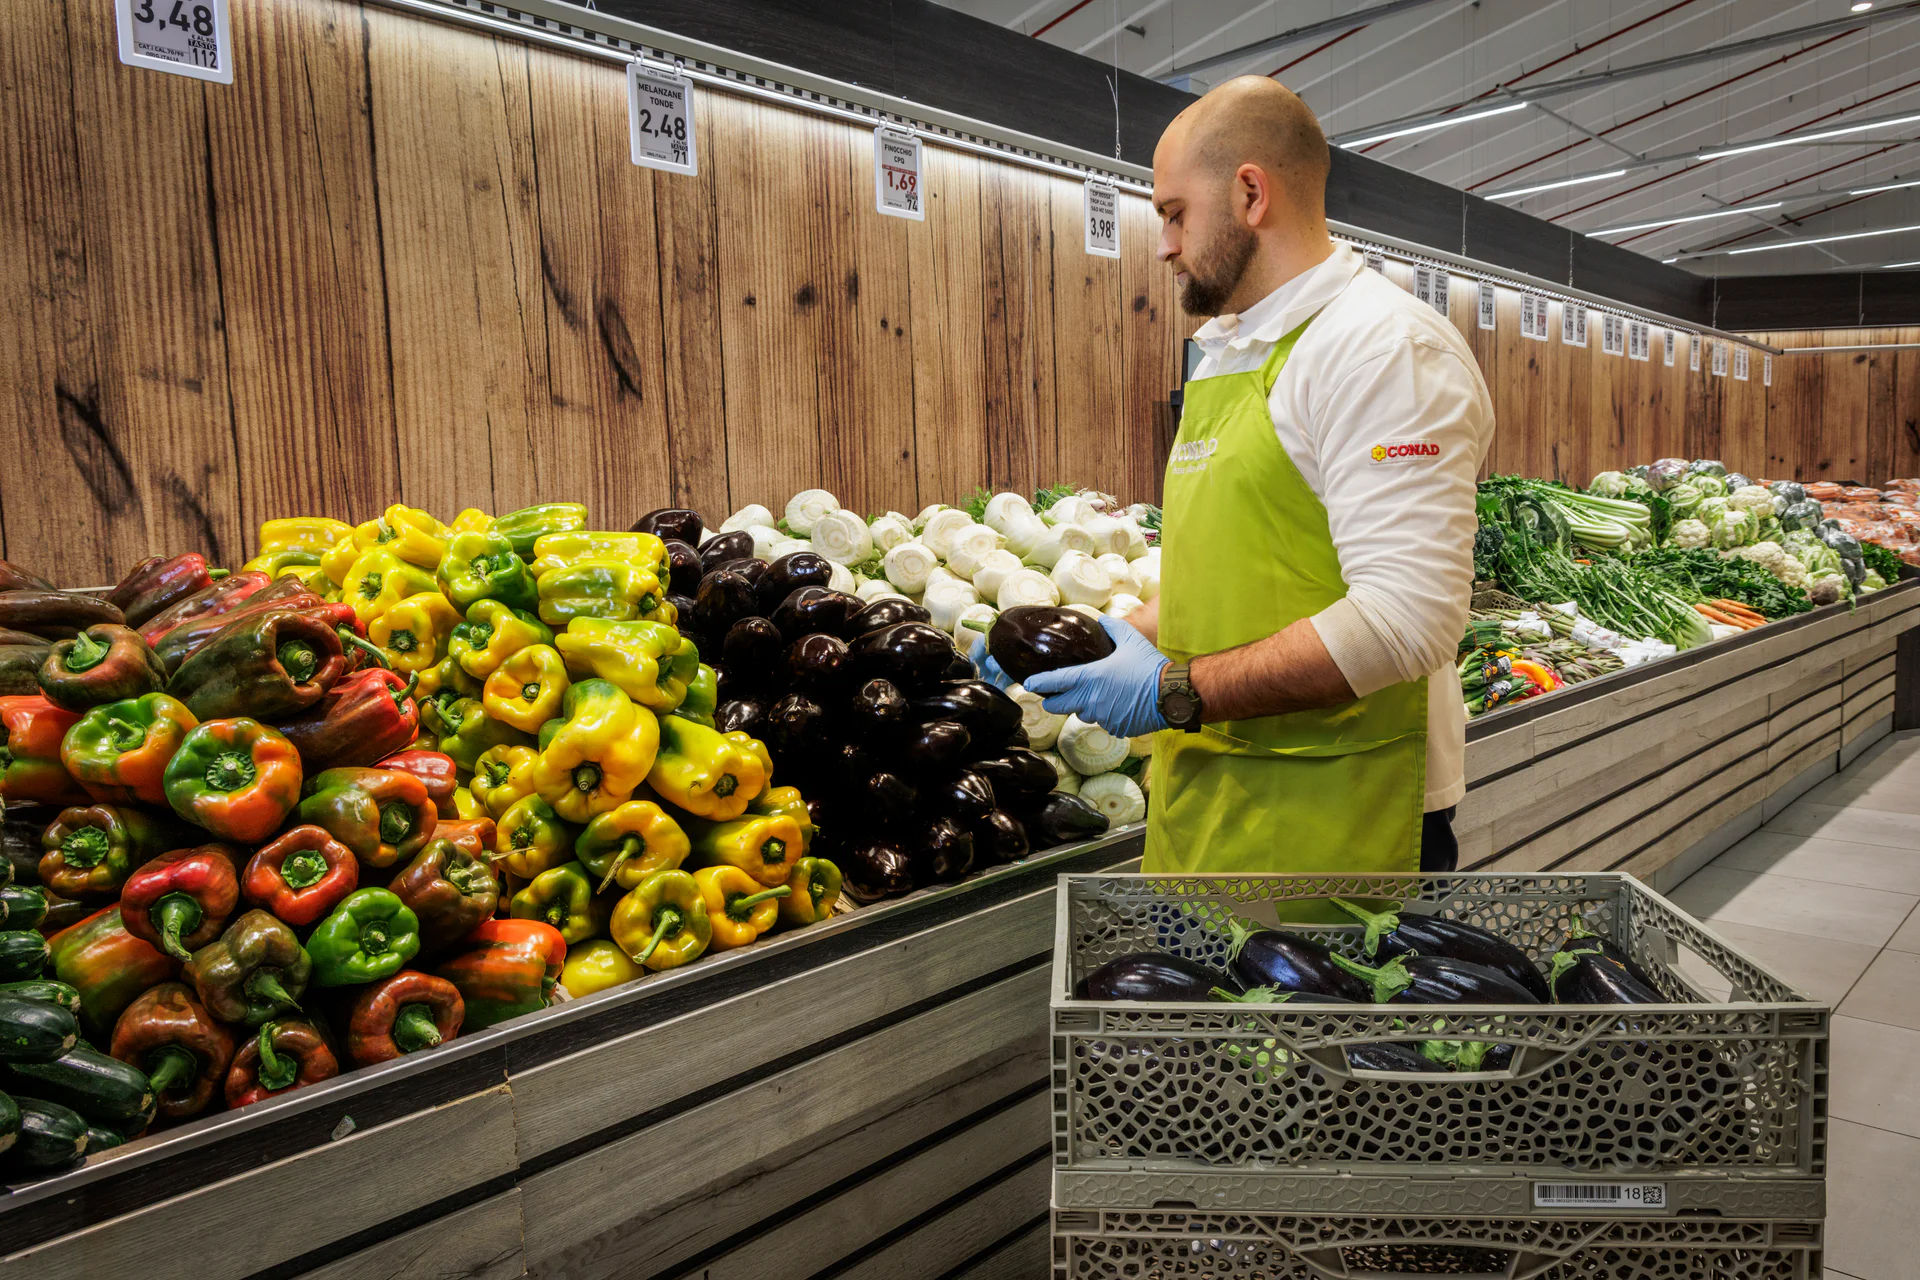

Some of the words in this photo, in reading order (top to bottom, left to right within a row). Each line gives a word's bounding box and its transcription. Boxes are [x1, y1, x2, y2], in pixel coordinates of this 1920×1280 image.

[134, 0, 213, 36] 3,48
[193, 47, 217, 68] 112
[638, 83, 682, 100] MELANZANE
[650, 96, 674, 109] TONDE
[640, 109, 686, 141] 2,48
[673, 150, 687, 165] 71
[884, 143, 913, 157] FINOCCHIO
[893, 155, 905, 165] CPQ
[887, 170, 917, 192] 1,69
[906, 199, 918, 212] 74
[1387, 443, 1440, 458] CONAD
[1624, 1187, 1641, 1199] 18
